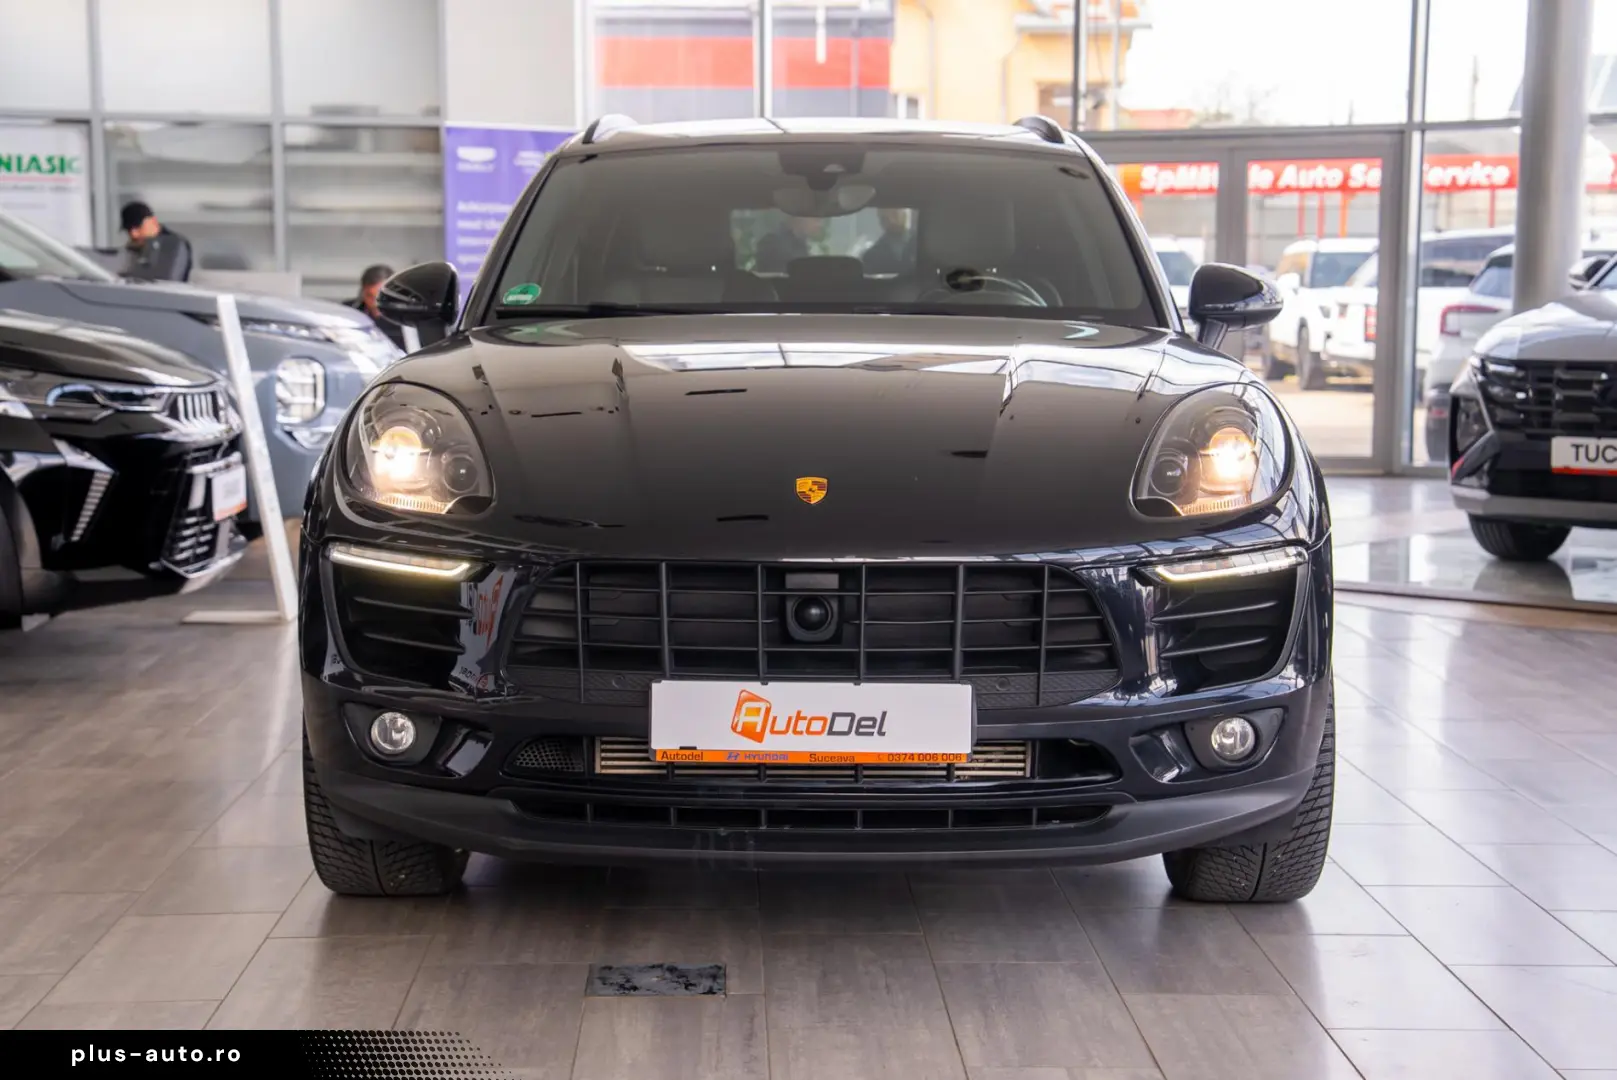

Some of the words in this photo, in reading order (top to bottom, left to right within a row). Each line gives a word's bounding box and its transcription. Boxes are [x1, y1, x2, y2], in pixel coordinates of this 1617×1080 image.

[1276, 164, 1344, 188] Auto
[1424, 160, 1510, 187] ervice
[1571, 443, 1617, 464] TUC
[734, 699, 887, 737] AutoDel
[661, 751, 704, 761] Autodel
[744, 753, 789, 761] HYUNDAI
[809, 753, 855, 763] Suceava
[887, 753, 915, 762] 0374
[918, 753, 938, 762] 006
[941, 753, 962, 762] 006
